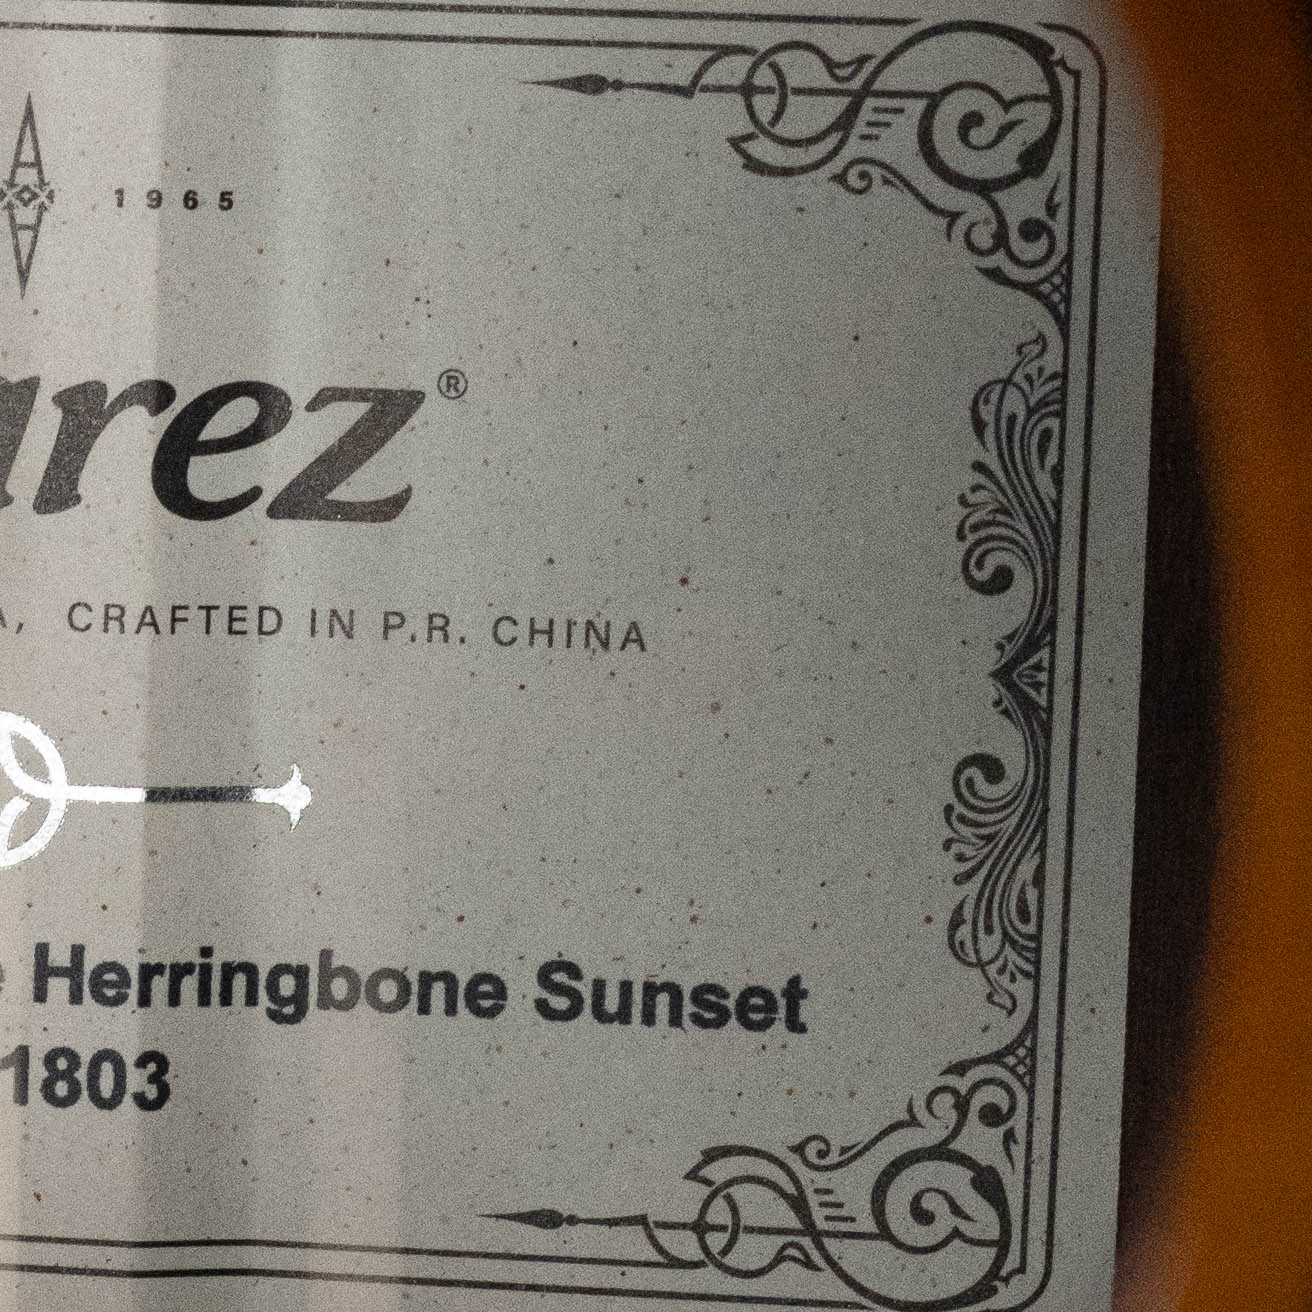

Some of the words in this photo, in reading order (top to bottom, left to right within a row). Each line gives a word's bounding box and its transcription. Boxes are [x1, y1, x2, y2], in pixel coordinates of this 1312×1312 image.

[113, 188, 235, 212] 1965
[67, 602, 283, 638] CRAFTED
[310, 607, 355, 639] IN
[382, 611, 468, 645] P.R.
[492, 615, 648, 653] CHINA
[32, 943, 508, 1025] Herringbone
[534, 960, 809, 1034] Sunset
